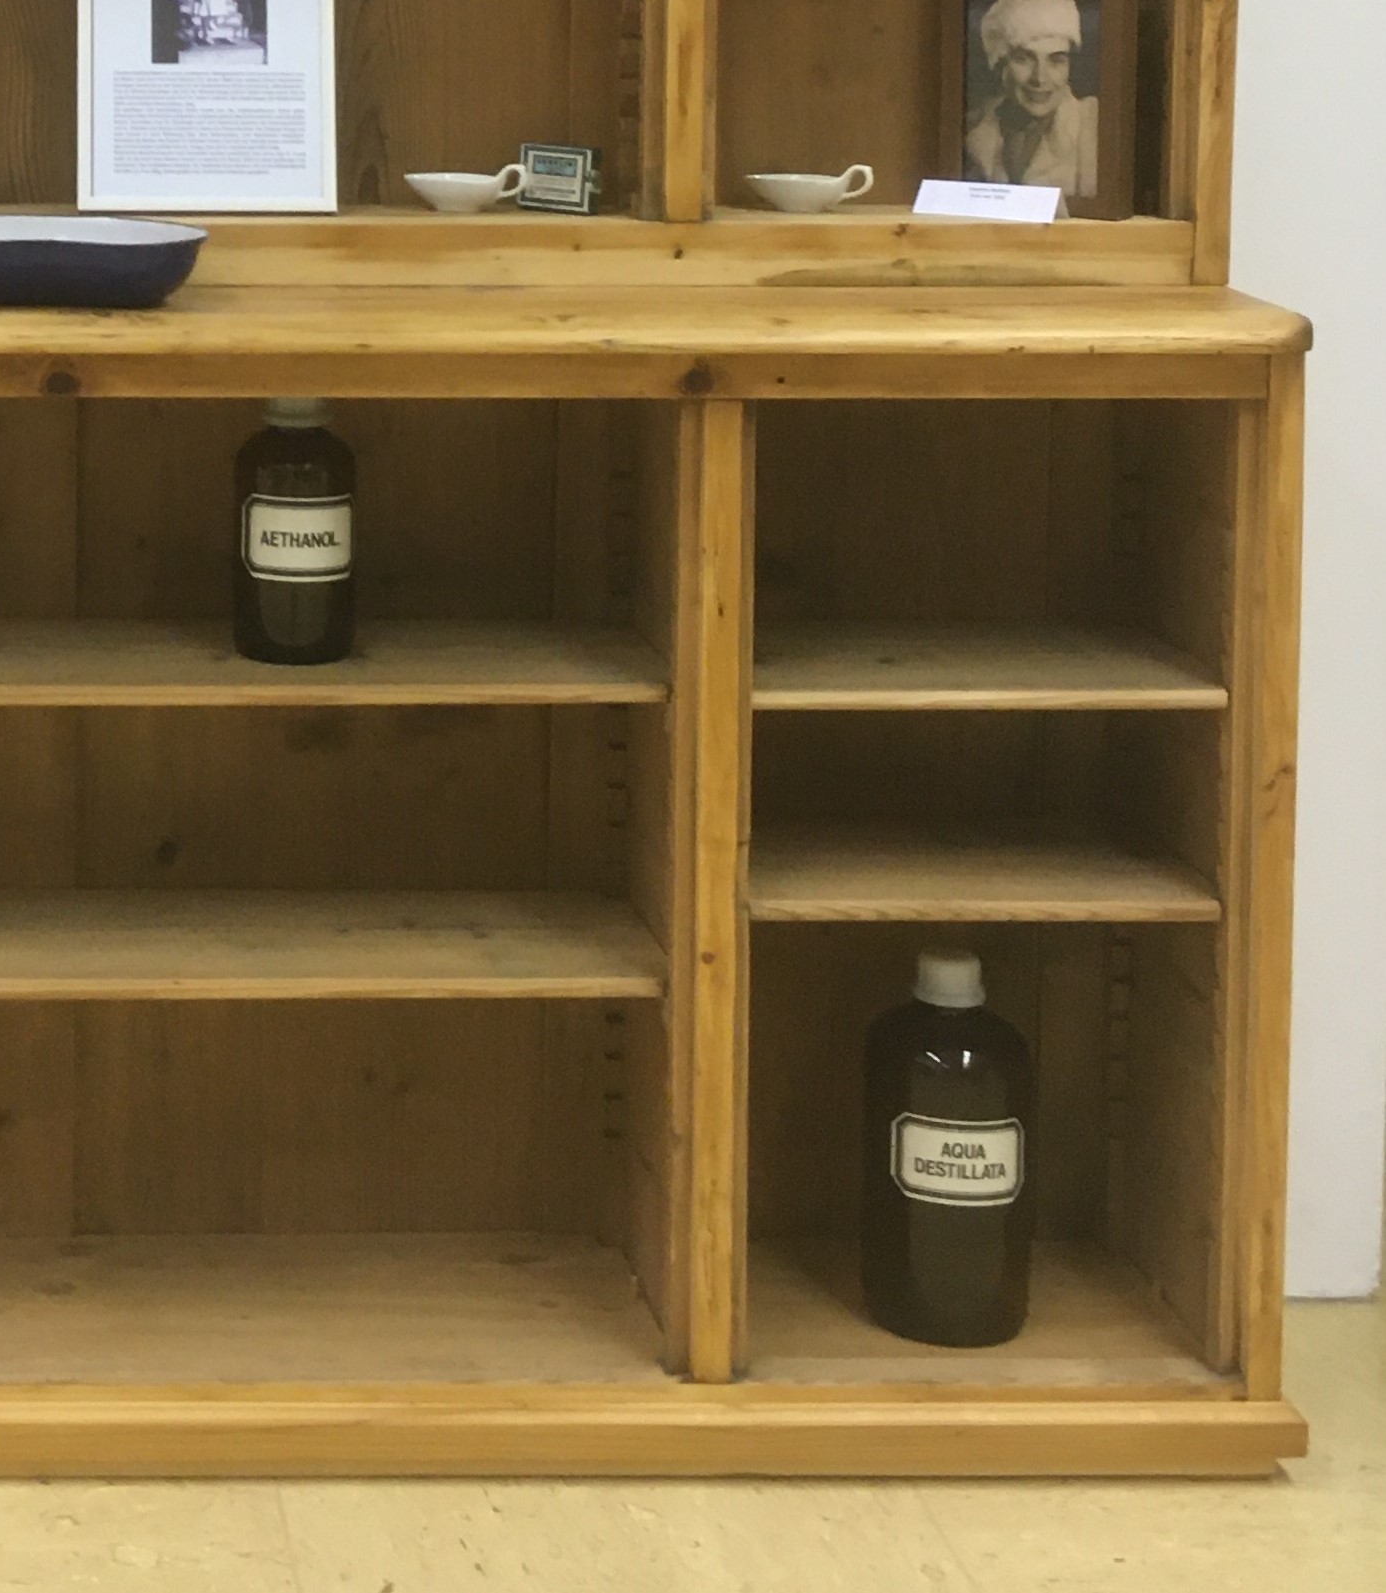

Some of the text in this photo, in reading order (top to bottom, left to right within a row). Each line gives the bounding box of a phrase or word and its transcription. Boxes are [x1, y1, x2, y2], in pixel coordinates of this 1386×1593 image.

[260, 530, 340, 548] AETHANOL
[940, 1142, 986, 1159] AQUA
[914, 1156, 1006, 1180] DESTILLATA
